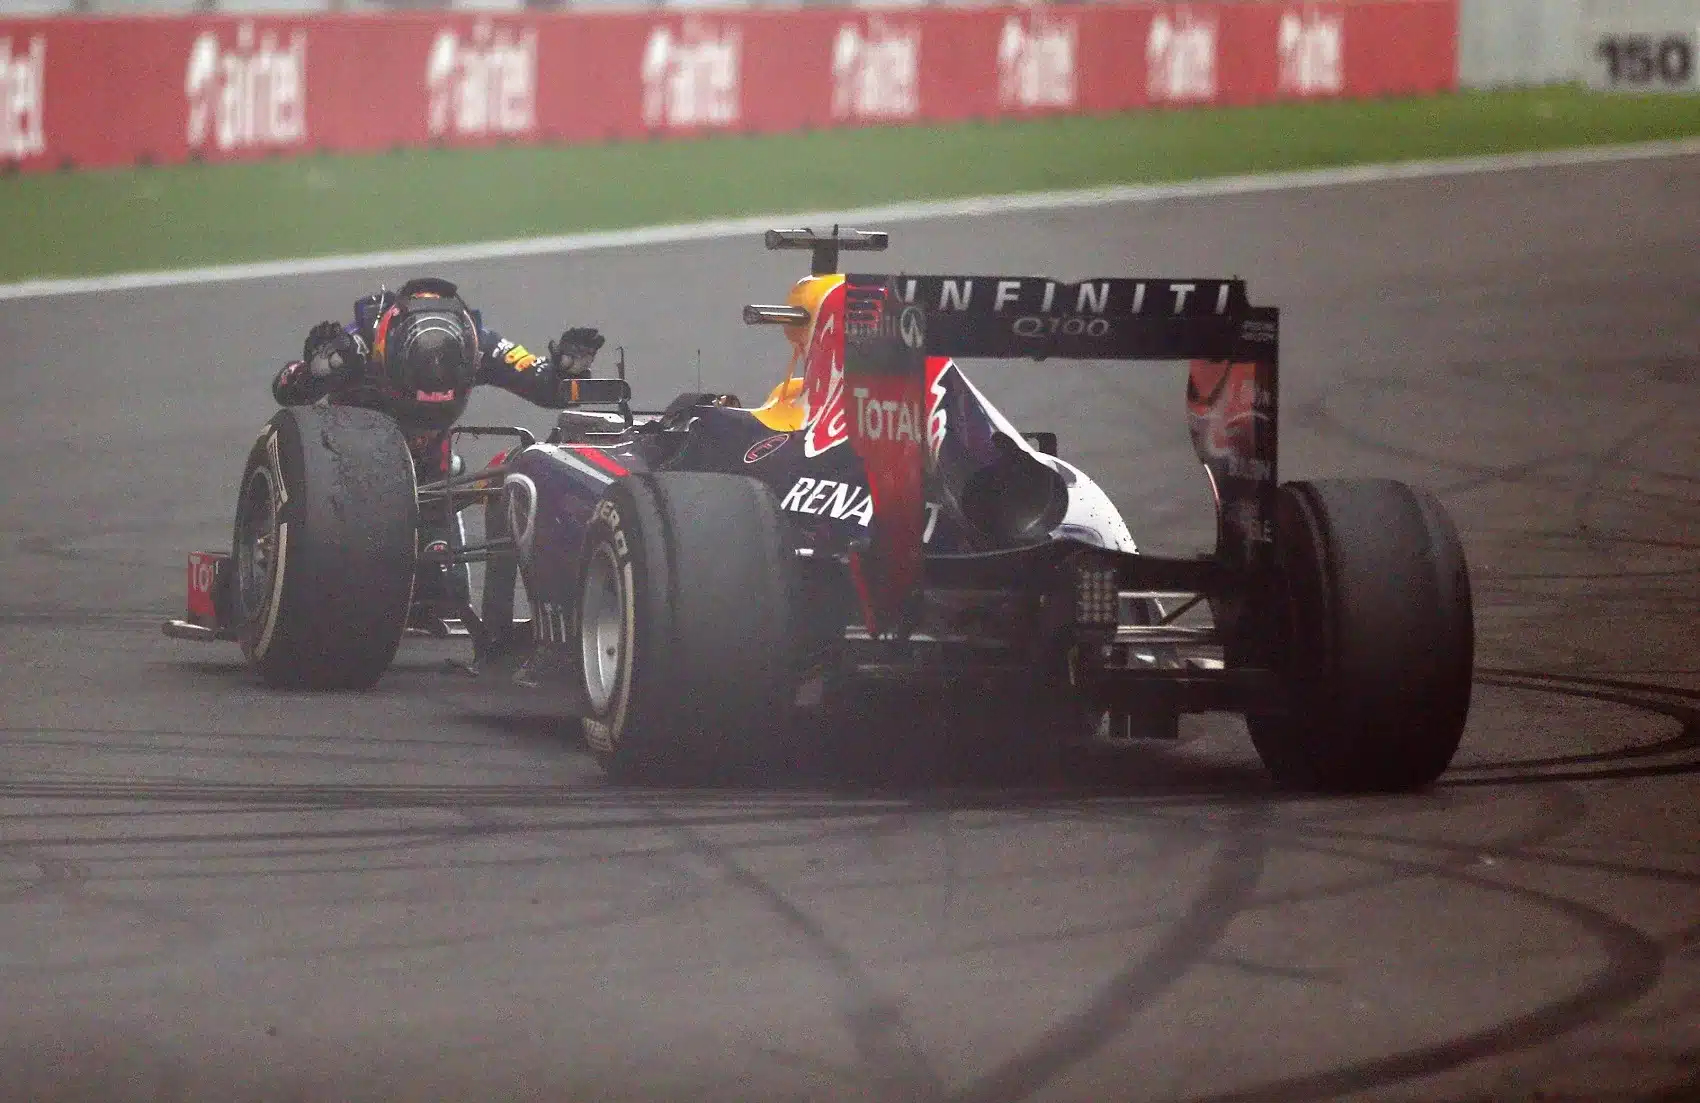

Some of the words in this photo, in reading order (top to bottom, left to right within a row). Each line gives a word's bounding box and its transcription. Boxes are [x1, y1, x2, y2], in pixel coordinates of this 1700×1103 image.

[1597, 36, 1692, 83] 150
[904, 279, 1230, 314] INFINITI
[780, 476, 942, 544] RENAT
